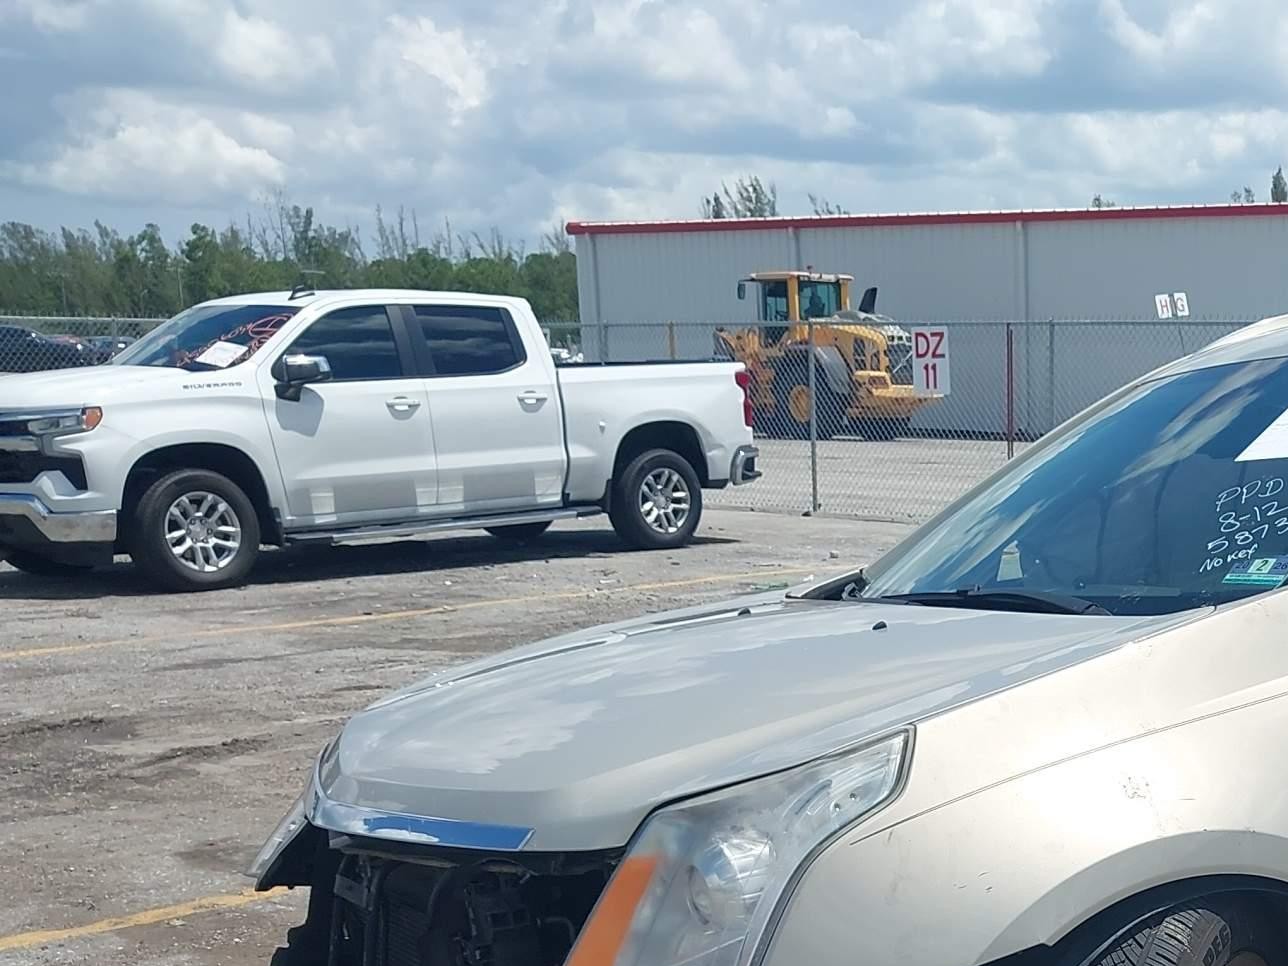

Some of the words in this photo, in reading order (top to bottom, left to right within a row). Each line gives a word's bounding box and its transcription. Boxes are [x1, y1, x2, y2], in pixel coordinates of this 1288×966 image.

[915, 332, 945, 358] DZ
[923, 363, 937, 389] 11
[1215, 478, 1284, 512] PPD
[1255, 559, 1268, 572] 2
[1274, 561, 1288, 570] 26
